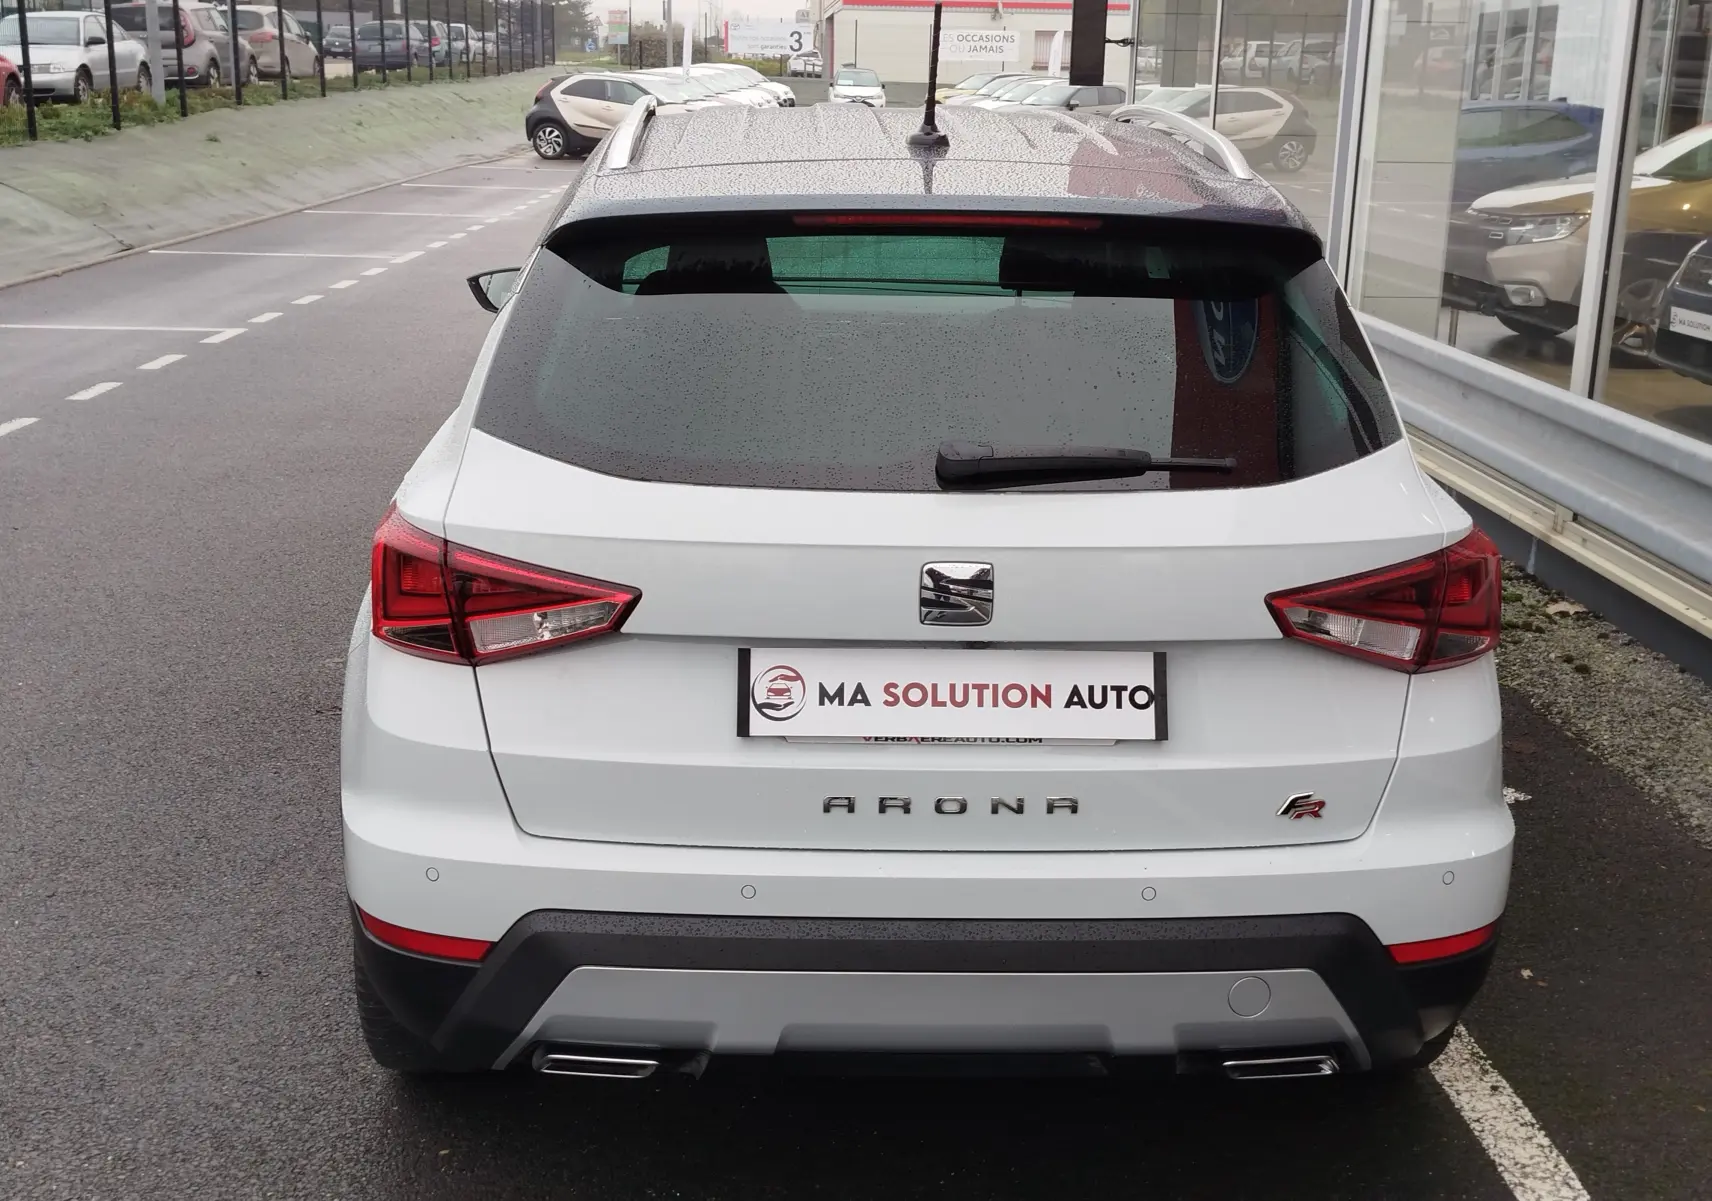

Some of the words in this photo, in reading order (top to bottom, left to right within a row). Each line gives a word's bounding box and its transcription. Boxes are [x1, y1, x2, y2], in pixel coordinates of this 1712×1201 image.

[789, 30, 803, 52] 3
[956, 34, 1015, 43] OCCASIONS
[967, 44, 1004, 54] JAMAIS
[818, 681, 872, 707] MA
[883, 682, 1052, 709] SOLUTION
[1063, 684, 1156, 710] AUTO
[823, 795, 1079, 815] ARONA
[1276, 791, 1326, 820] FR
